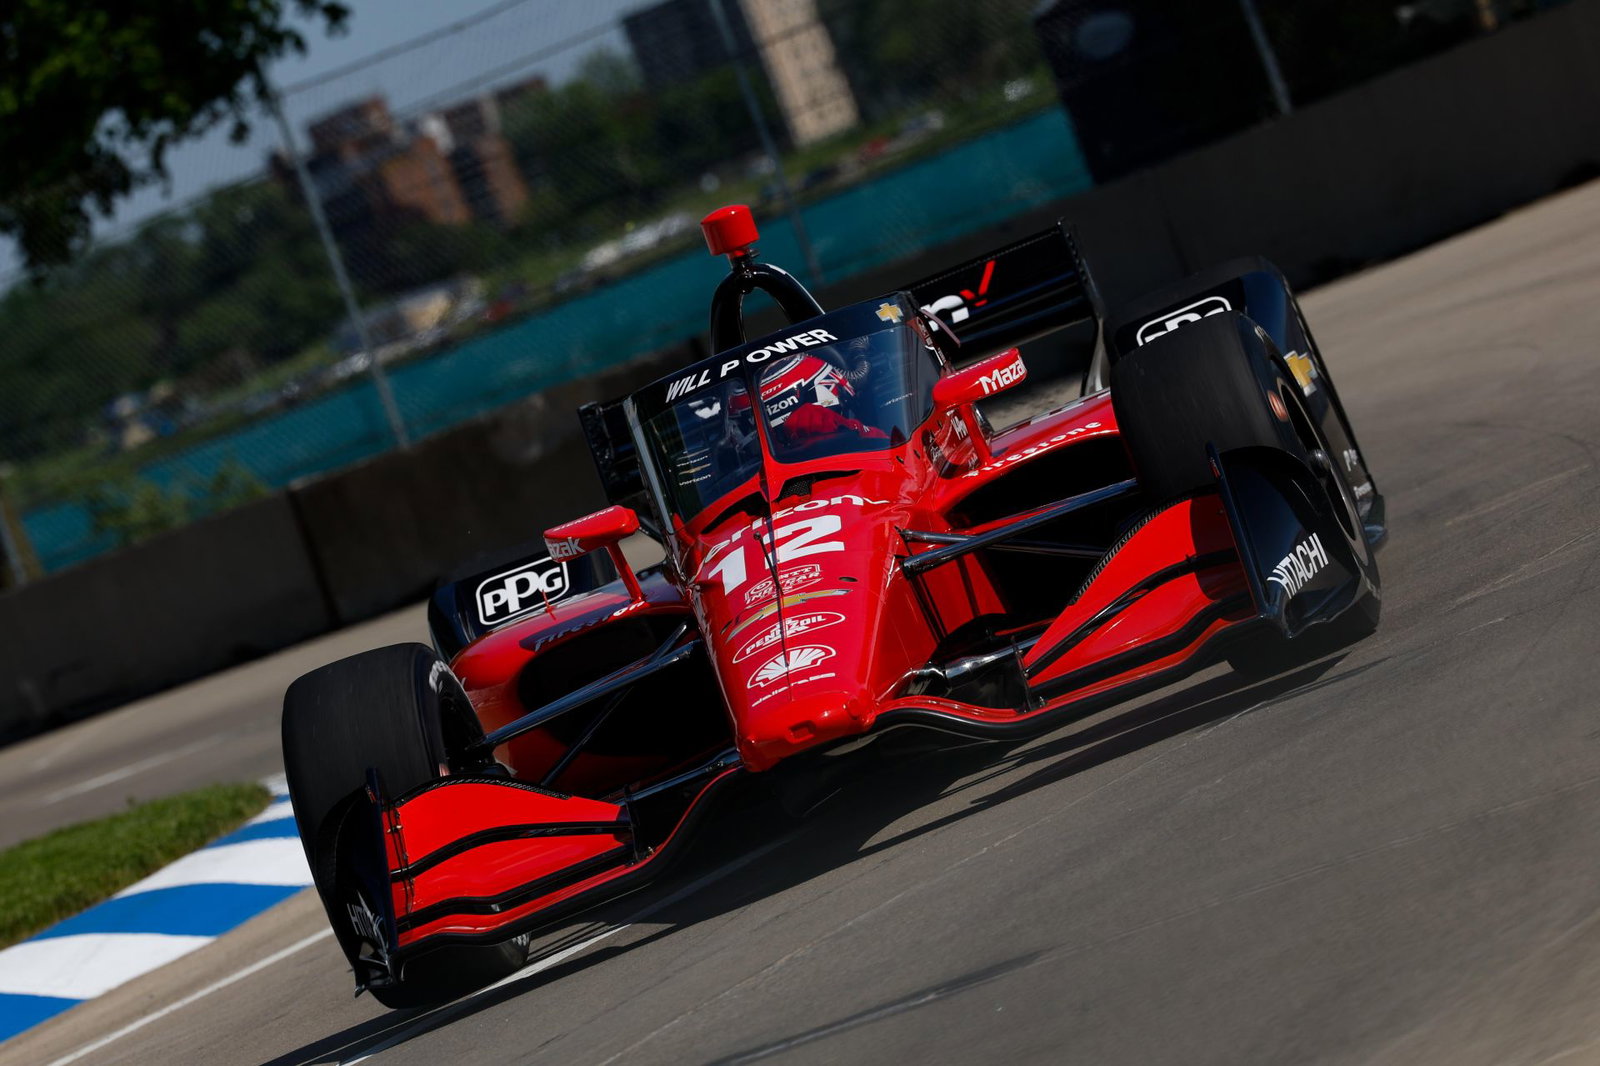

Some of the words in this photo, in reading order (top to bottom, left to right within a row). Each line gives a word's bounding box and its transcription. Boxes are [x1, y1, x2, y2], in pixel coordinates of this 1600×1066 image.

[665, 369, 712, 404] WILL
[761, 382, 783, 397] COTT
[766, 395, 799, 416] izon
[962, 421, 1102, 479] Firestone
[546, 536, 586, 560] azak
[703, 494, 865, 564] erizon
[707, 514, 846, 597] 12
[1266, 532, 1330, 600] HITACHI
[482, 566, 564, 617] PPG
[745, 571, 821, 605] INDCAR
